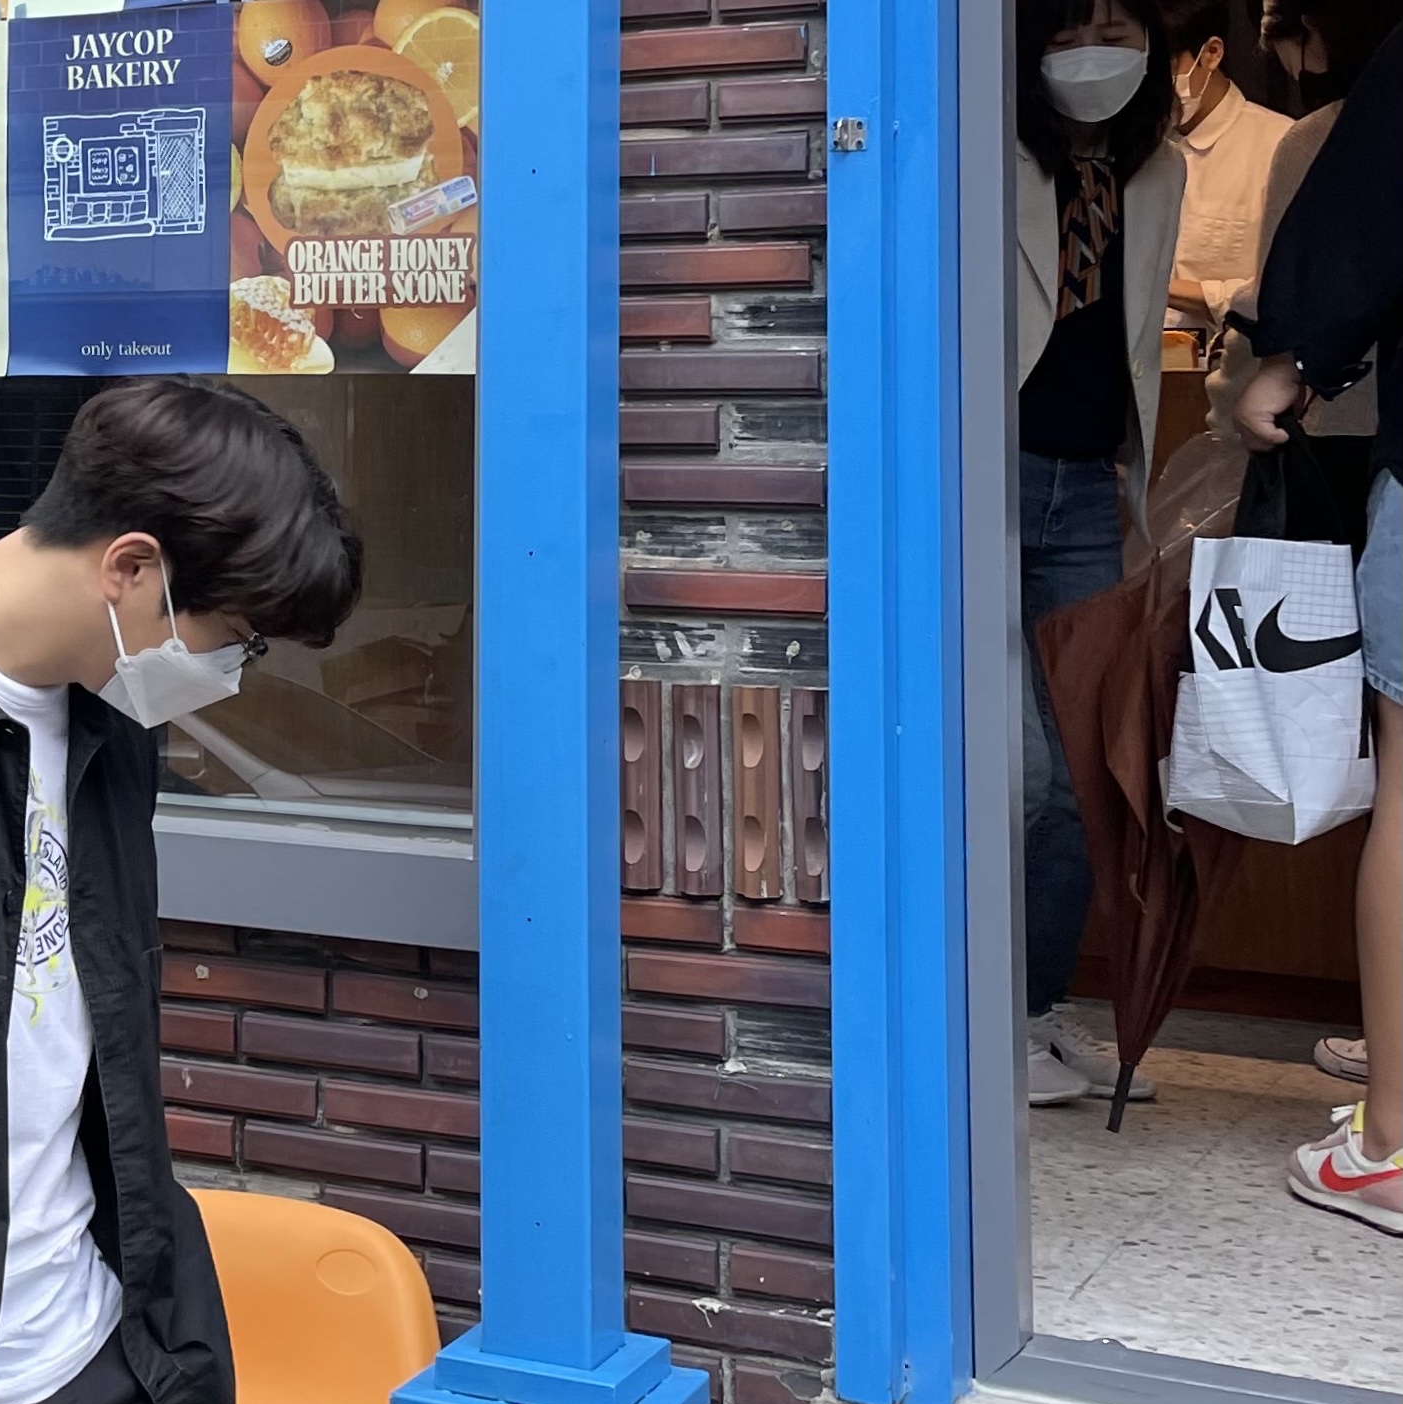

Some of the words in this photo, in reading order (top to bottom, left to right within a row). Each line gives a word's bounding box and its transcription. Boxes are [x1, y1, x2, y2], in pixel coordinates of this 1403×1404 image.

[65, 28, 173, 60] JAYCOP
[67, 58, 182, 91] BAKERY
[287, 239, 385, 272] ORANGE
[389, 237, 472, 271] HONEY
[293, 272, 387, 305] BUTTER
[392, 270, 467, 304] SCONE
[81, 340, 114, 360] only
[118, 340, 172, 356] takeout
